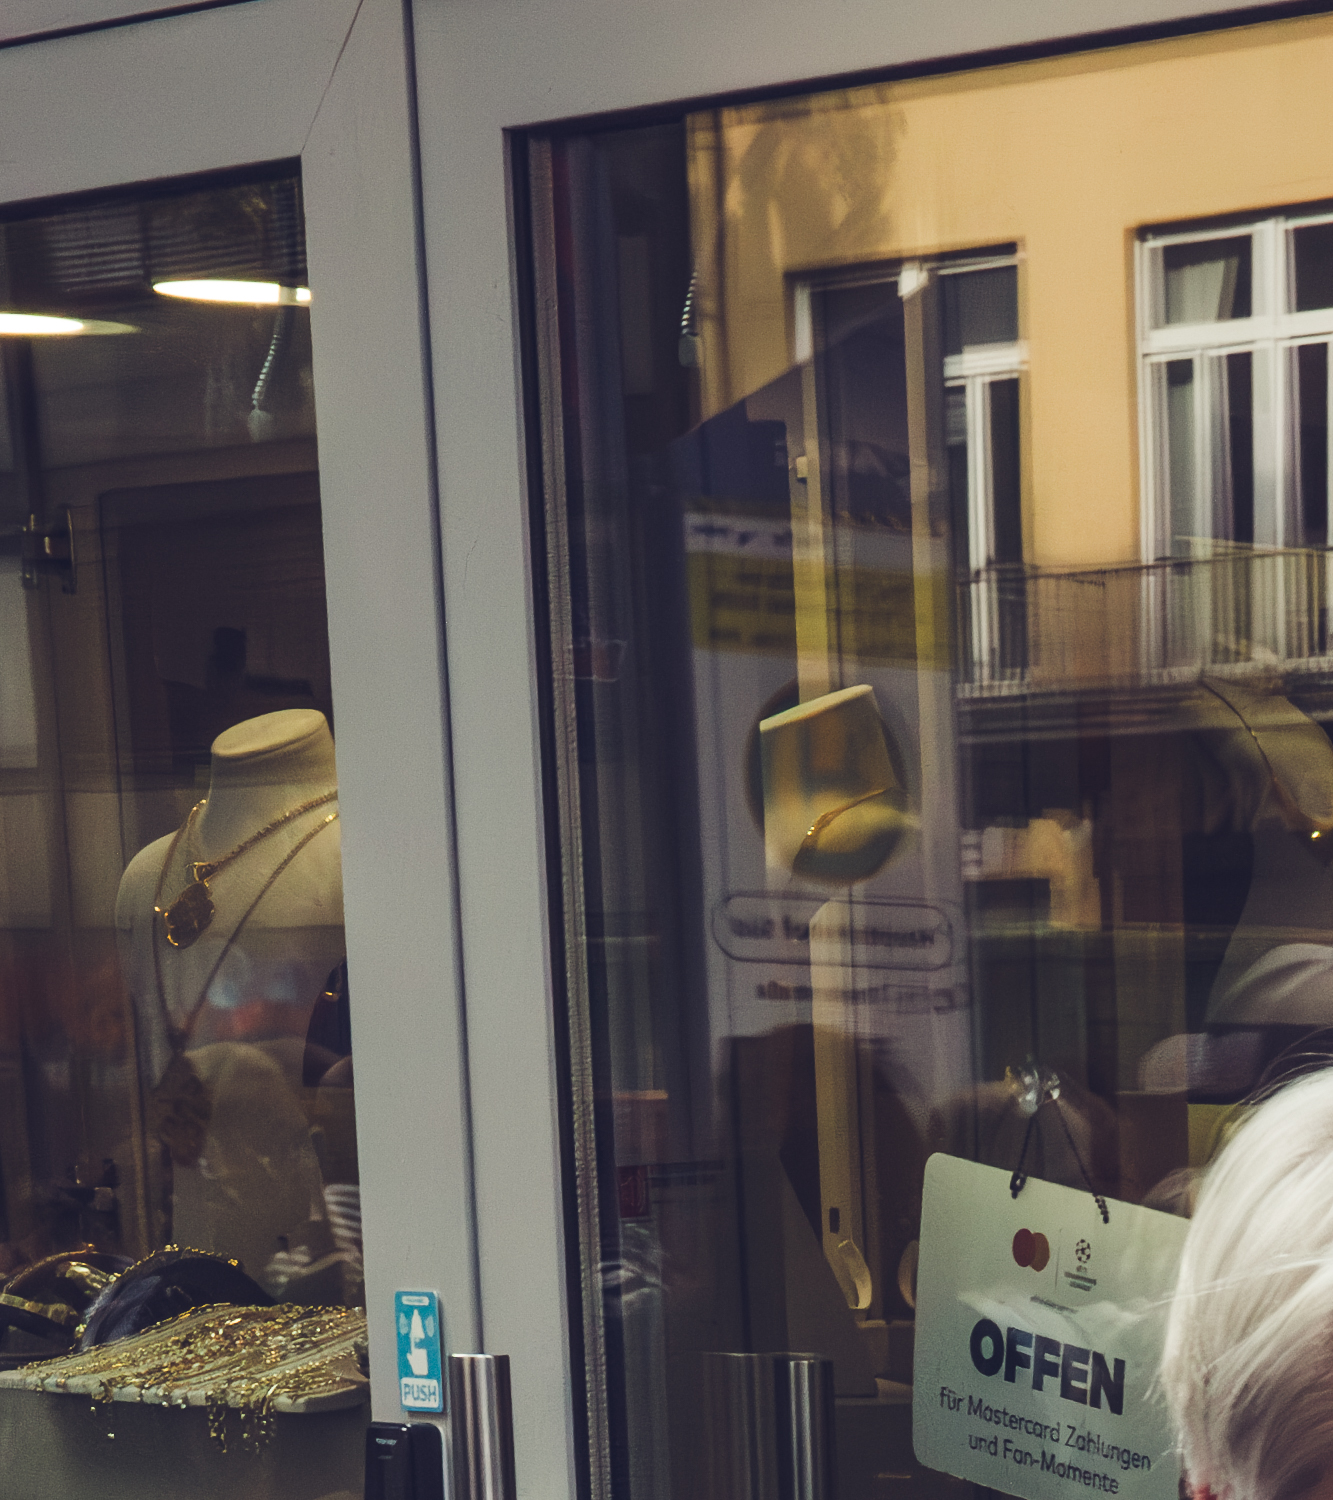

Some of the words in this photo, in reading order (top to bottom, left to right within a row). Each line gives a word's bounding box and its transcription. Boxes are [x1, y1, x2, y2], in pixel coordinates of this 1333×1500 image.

[402, 1382, 438, 1404] PUSH
[969, 1318, 1127, 1417] OFFEN
[939, 1386, 964, 1413] für
[967, 1394, 1061, 1444] Mastercard
[1065, 1425, 1152, 1472] Zahlungen
[968, 1432, 998, 1457] und
[1002, 1440, 1120, 1496] Fan-Momente
